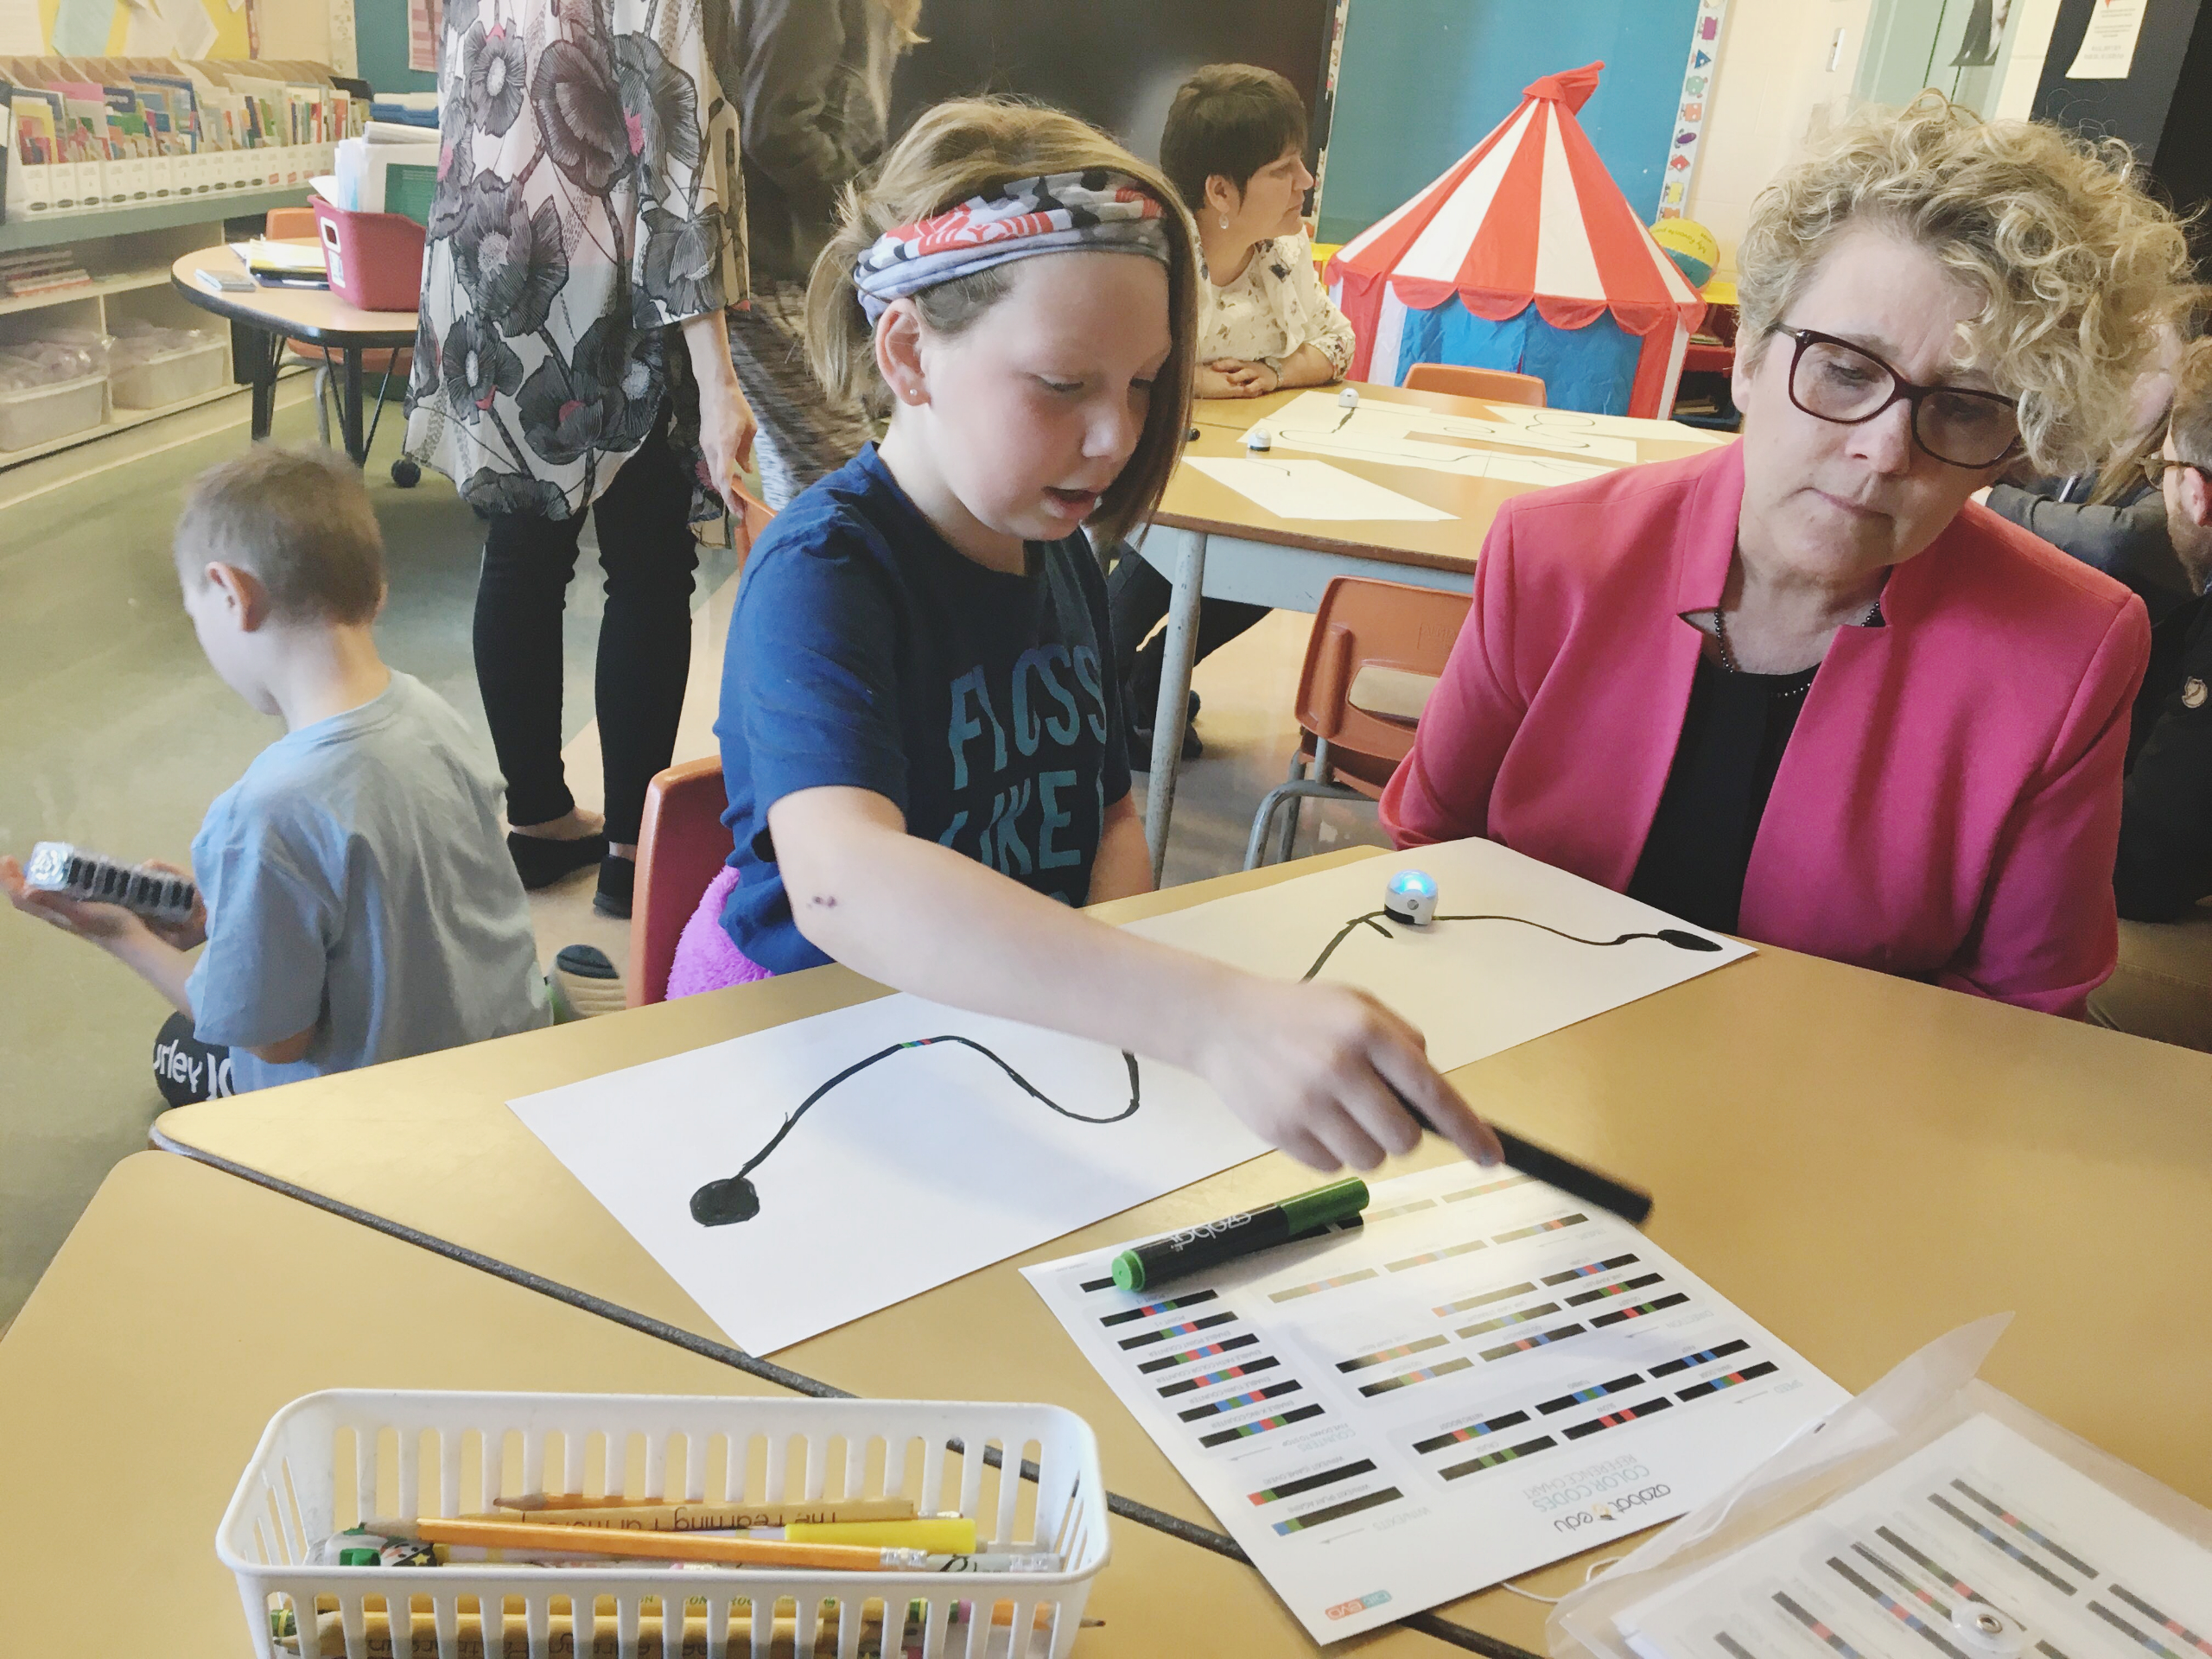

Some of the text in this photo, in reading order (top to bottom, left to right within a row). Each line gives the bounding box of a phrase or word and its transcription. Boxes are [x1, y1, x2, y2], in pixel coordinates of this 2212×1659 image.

[1204, 1330, 1231, 1341] ENABLE
[1147, 1343, 1183, 1357] COUNTER
[1234, 1349, 1262, 1361] ENABLE
[1154, 1369, 1191, 1383] COUNTER
[1243, 1376, 1271, 1387] ENABLE
[1770, 1379, 1805, 1395] SPEED
[1187, 1389, 1224, 1404] COUNTER
[1267, 1400, 1294, 1411] ENABLE
[1210, 1414, 1247, 1428] COUNTER
[1294, 1427, 1358, 1453] COUNTERS
[1519, 1452, 1640, 1500] REFERENCE CHART
[1529, 1463, 1655, 1513] COLOR CODES
[1550, 1482, 1678, 1535] ozobot edu
[1370, 1505, 1433, 1532] WIN/EXITS
